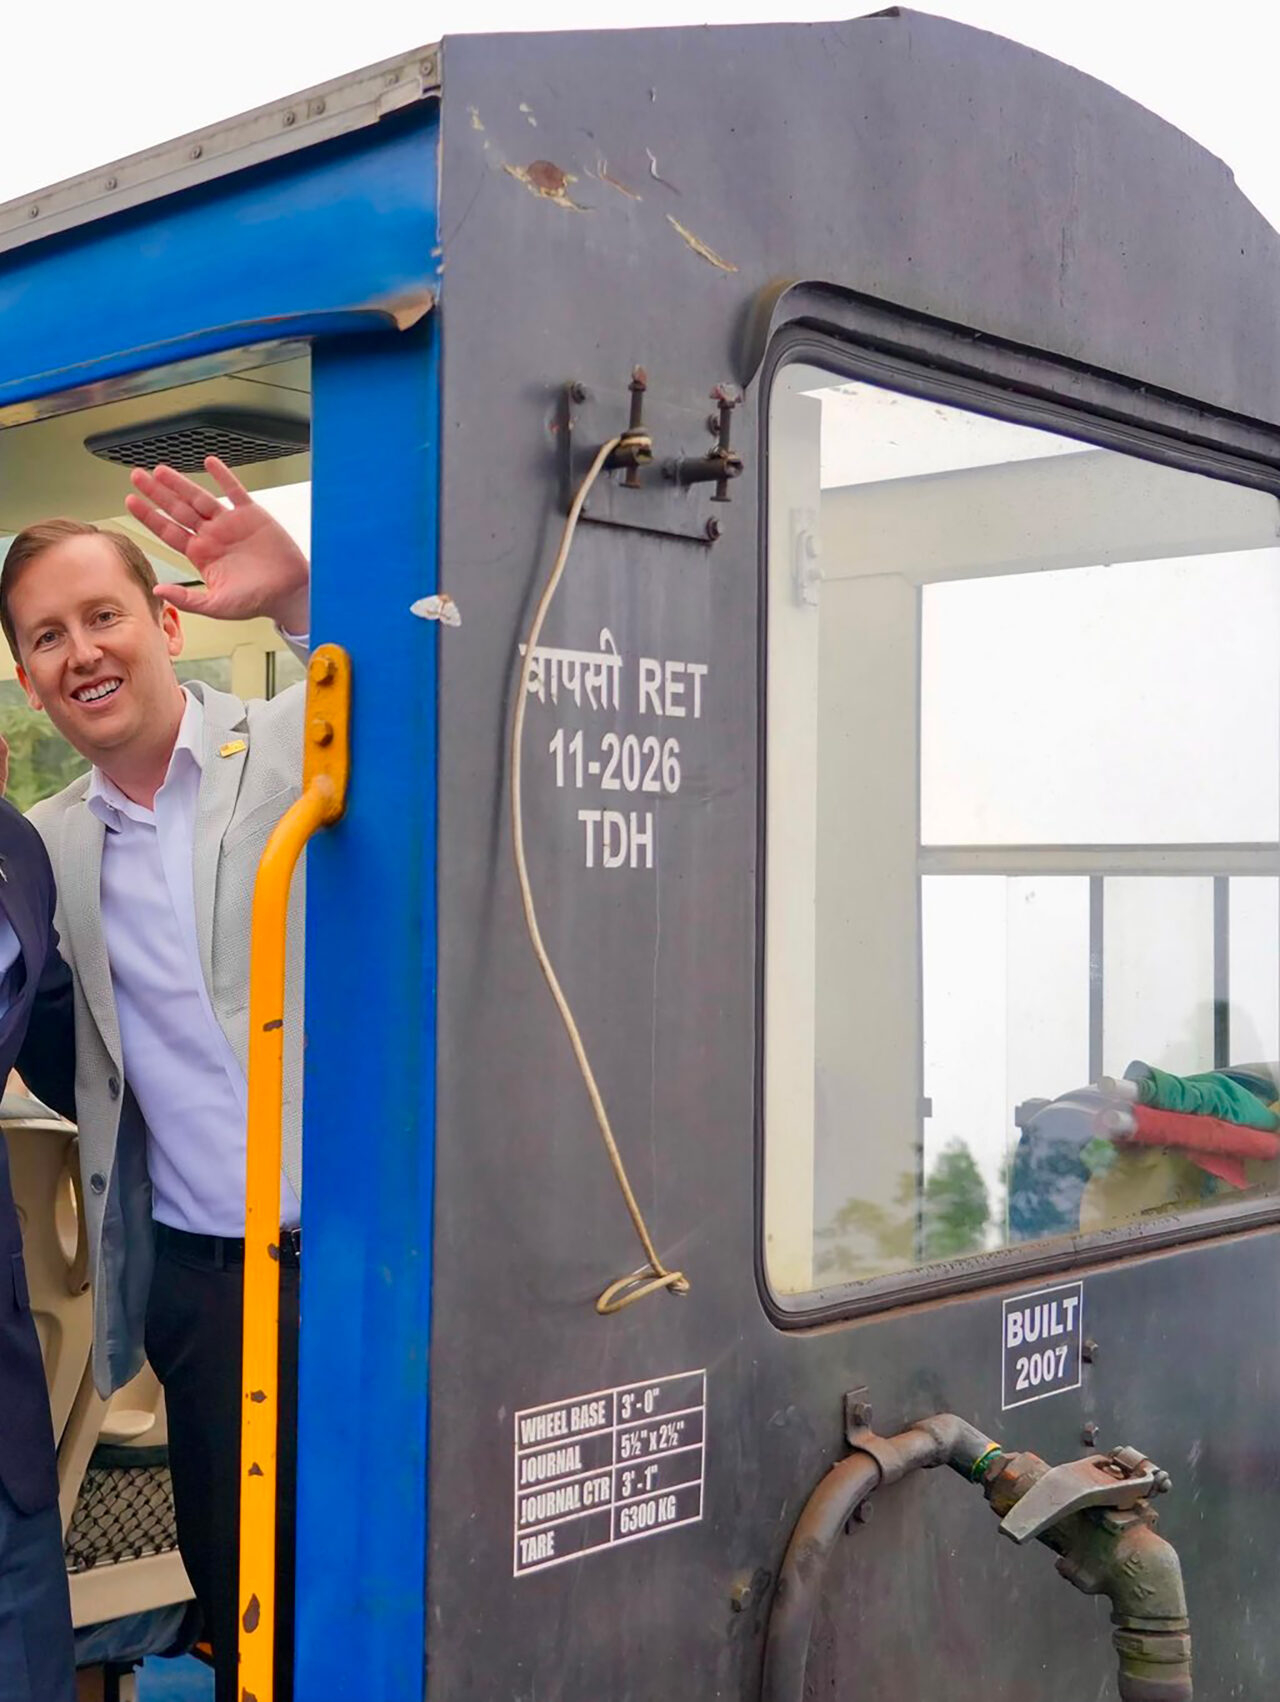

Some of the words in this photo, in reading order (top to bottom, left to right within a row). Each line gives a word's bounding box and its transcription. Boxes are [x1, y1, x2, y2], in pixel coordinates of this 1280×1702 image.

[519, 627, 623, 711] वापसी
[639, 657, 708, 719] RET
[549, 728, 681, 793] 11-2026
[578, 809, 653, 869] TDH
[1006, 1296, 1079, 1349] BUILT
[1015, 1344, 1068, 1391] 2007
[520, 1410, 568, 1444] WHEEL
[571, 1400, 606, 1432] BASE
[520, 1445, 582, 1485] JOURNAL
[520, 1484, 581, 1524] JOURNAL
[583, 1476, 610, 1506] CTR
[620, 1500, 656, 1533] 6300
[658, 1495, 677, 1522] KG
[520, 1530, 555, 1564] TARE
